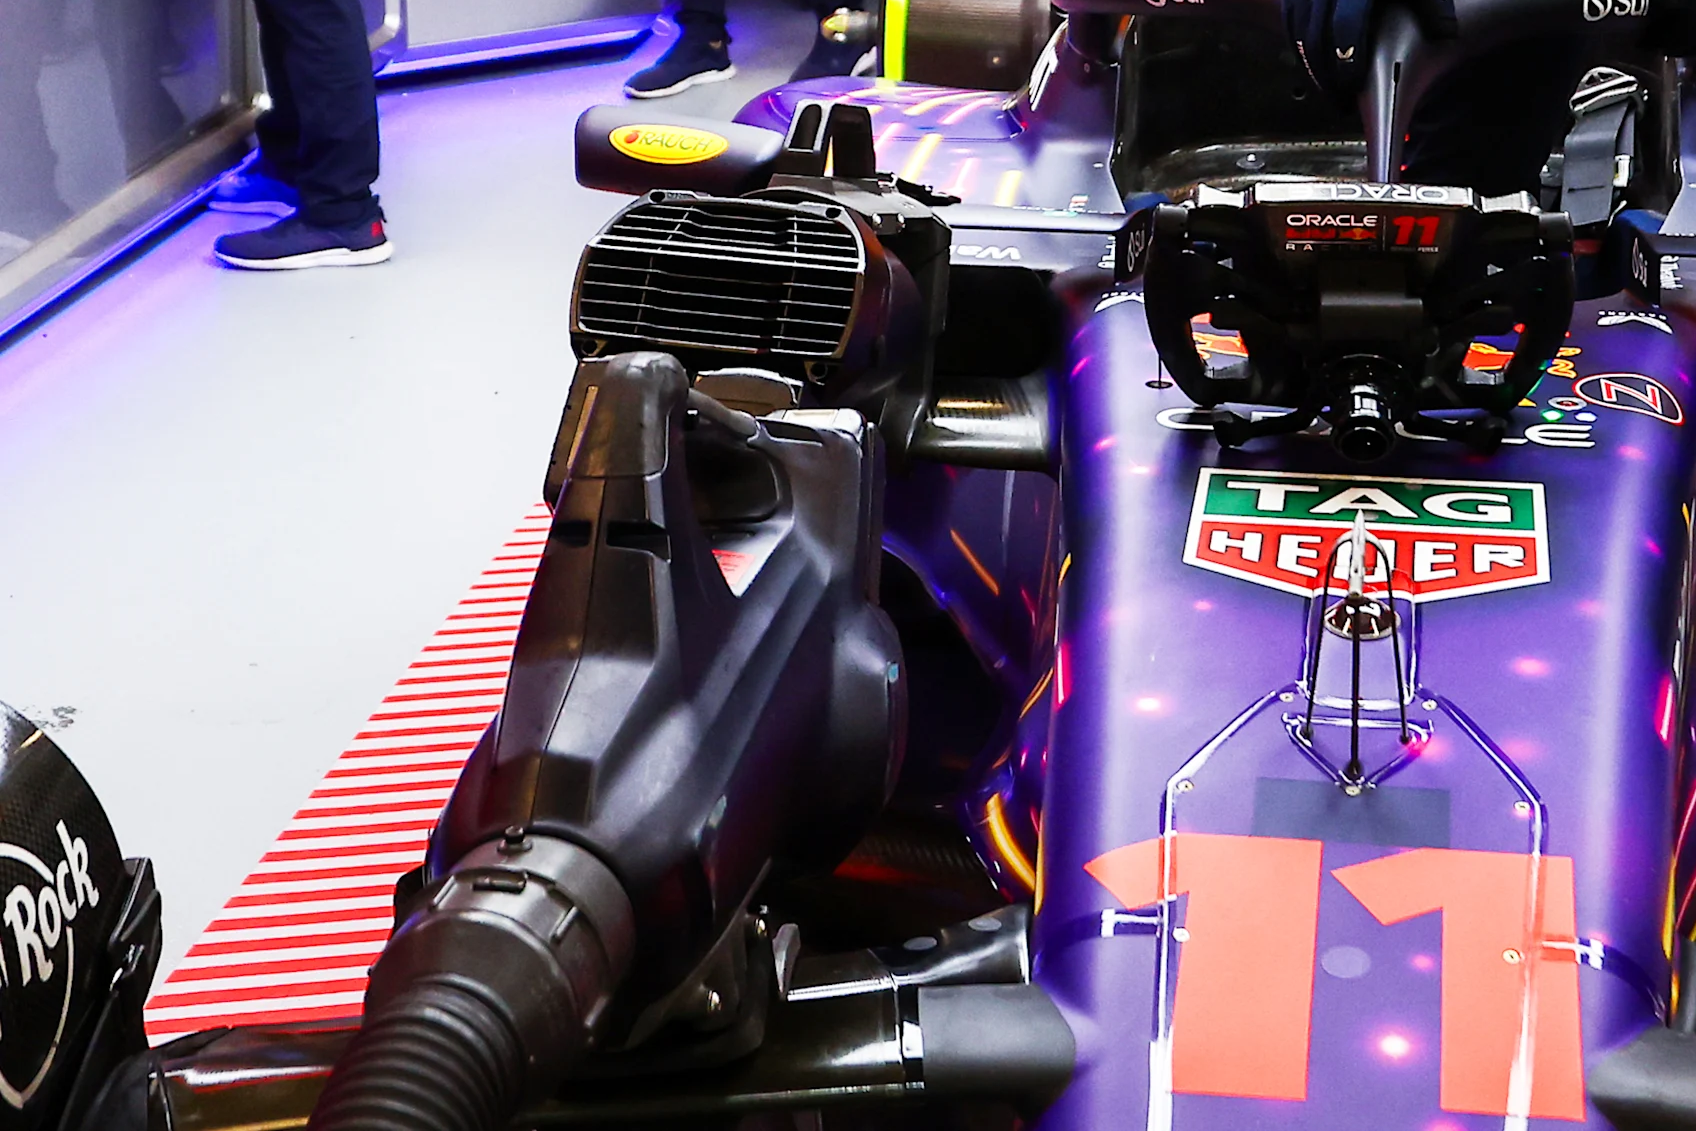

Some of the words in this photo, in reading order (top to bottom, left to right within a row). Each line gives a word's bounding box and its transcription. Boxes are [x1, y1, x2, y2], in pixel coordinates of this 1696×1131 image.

[640, 129, 712, 154] RAUCH
[1286, 214, 1378, 227] ORACLE
[1392, 215, 1440, 246] 11
[1226, 480, 1513, 524] TAG
[1208, 529, 1527, 579] HEUER
[3, 819, 99, 988] Rock
[1084, 832, 1586, 1122] 11
